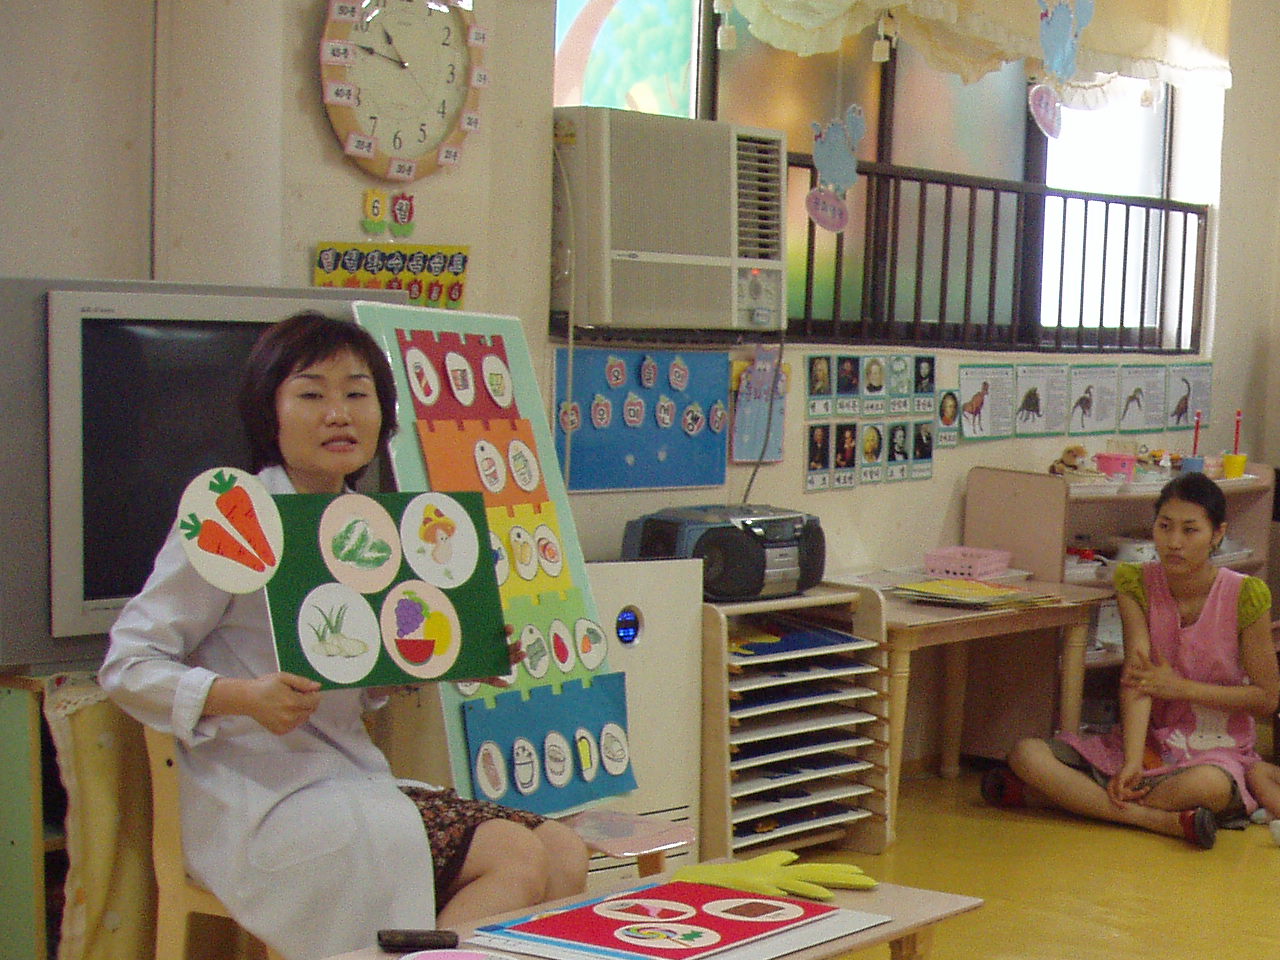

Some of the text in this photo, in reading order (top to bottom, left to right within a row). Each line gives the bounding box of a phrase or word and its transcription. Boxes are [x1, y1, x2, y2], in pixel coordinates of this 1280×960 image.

[441, 26, 451, 47] 2
[445, 64, 456, 84] 3
[437, 99, 447, 119] 4
[369, 116, 378, 137] 7
[417, 123, 427, 143] 5
[392, 130, 402, 150] 6
[372, 199, 410, 224] 6 월
